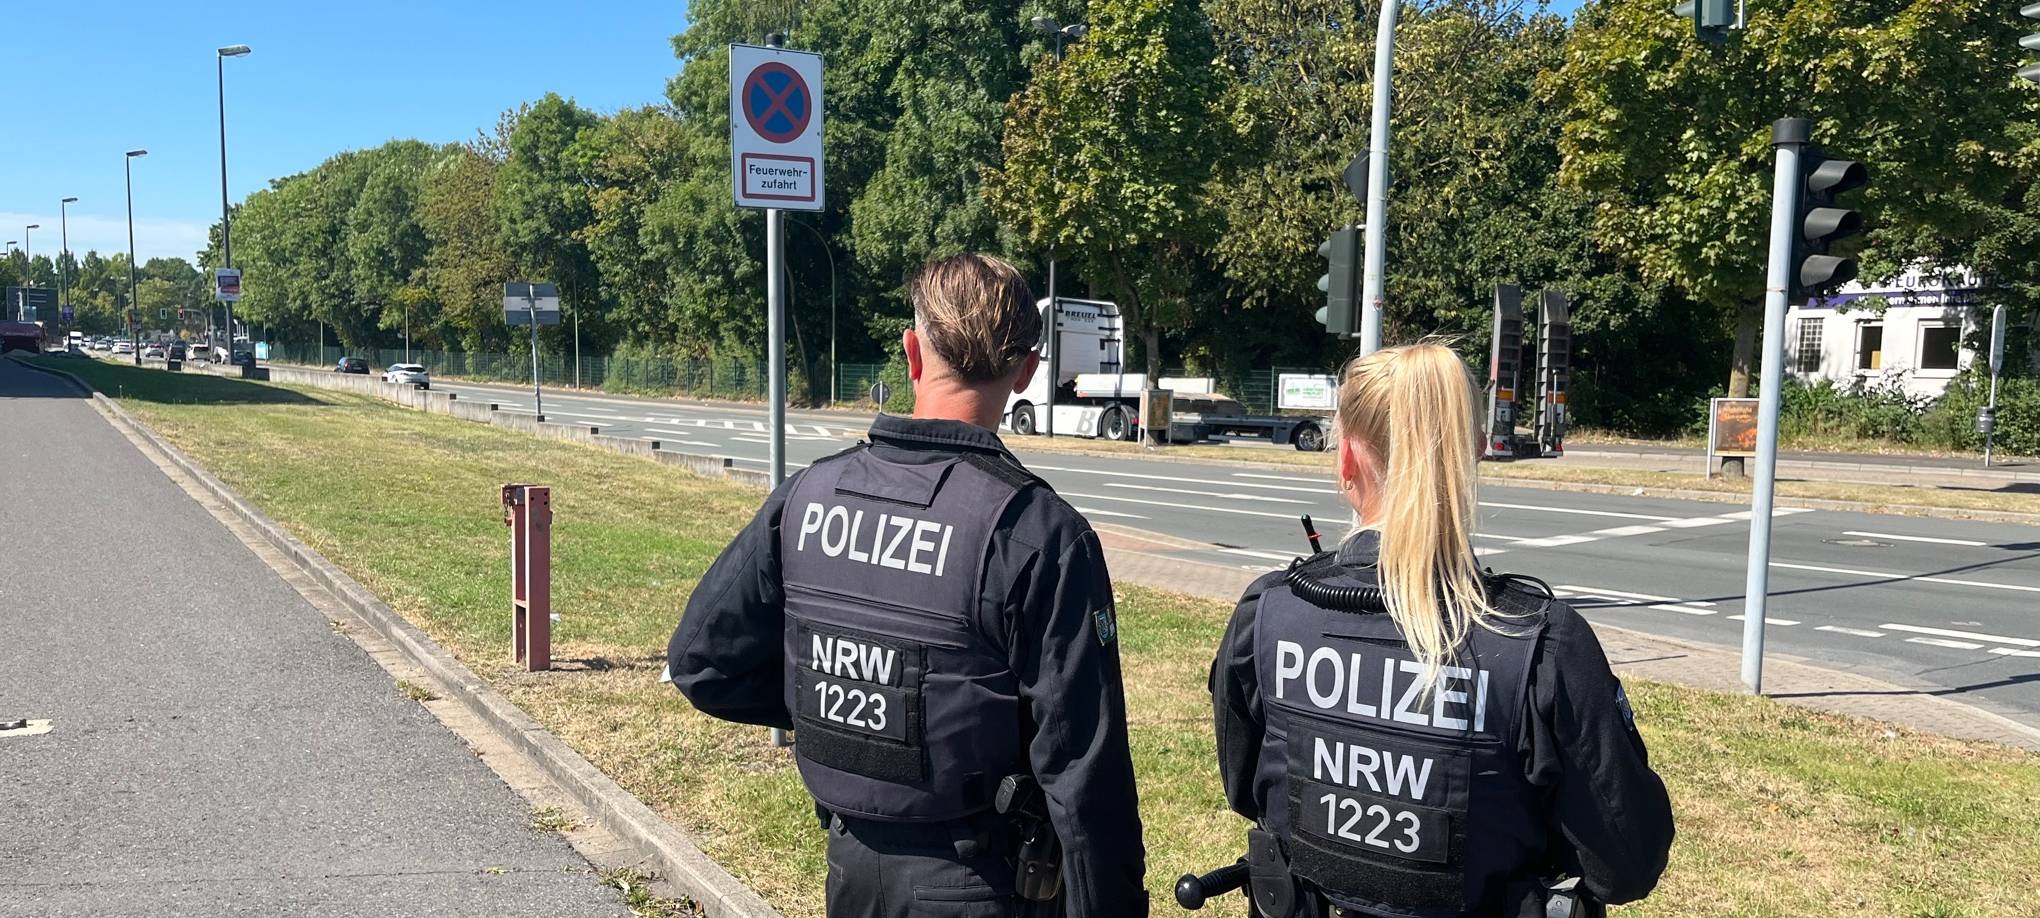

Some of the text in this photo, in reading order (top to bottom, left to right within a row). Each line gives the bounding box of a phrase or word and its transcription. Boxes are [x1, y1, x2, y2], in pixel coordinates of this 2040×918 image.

[749, 164, 808, 177] Feuerwehr-
[761, 179, 797, 190] zufahrt
[1076, 410, 1096, 434] B
[797, 502, 954, 577] POLIZEI
[812, 634, 895, 685] NRW
[814, 680, 887, 731] 1223
[1275, 640, 1490, 732] POLIZEI
[1313, 737, 1434, 800] NRW
[1320, 793, 1421, 853] 1223
